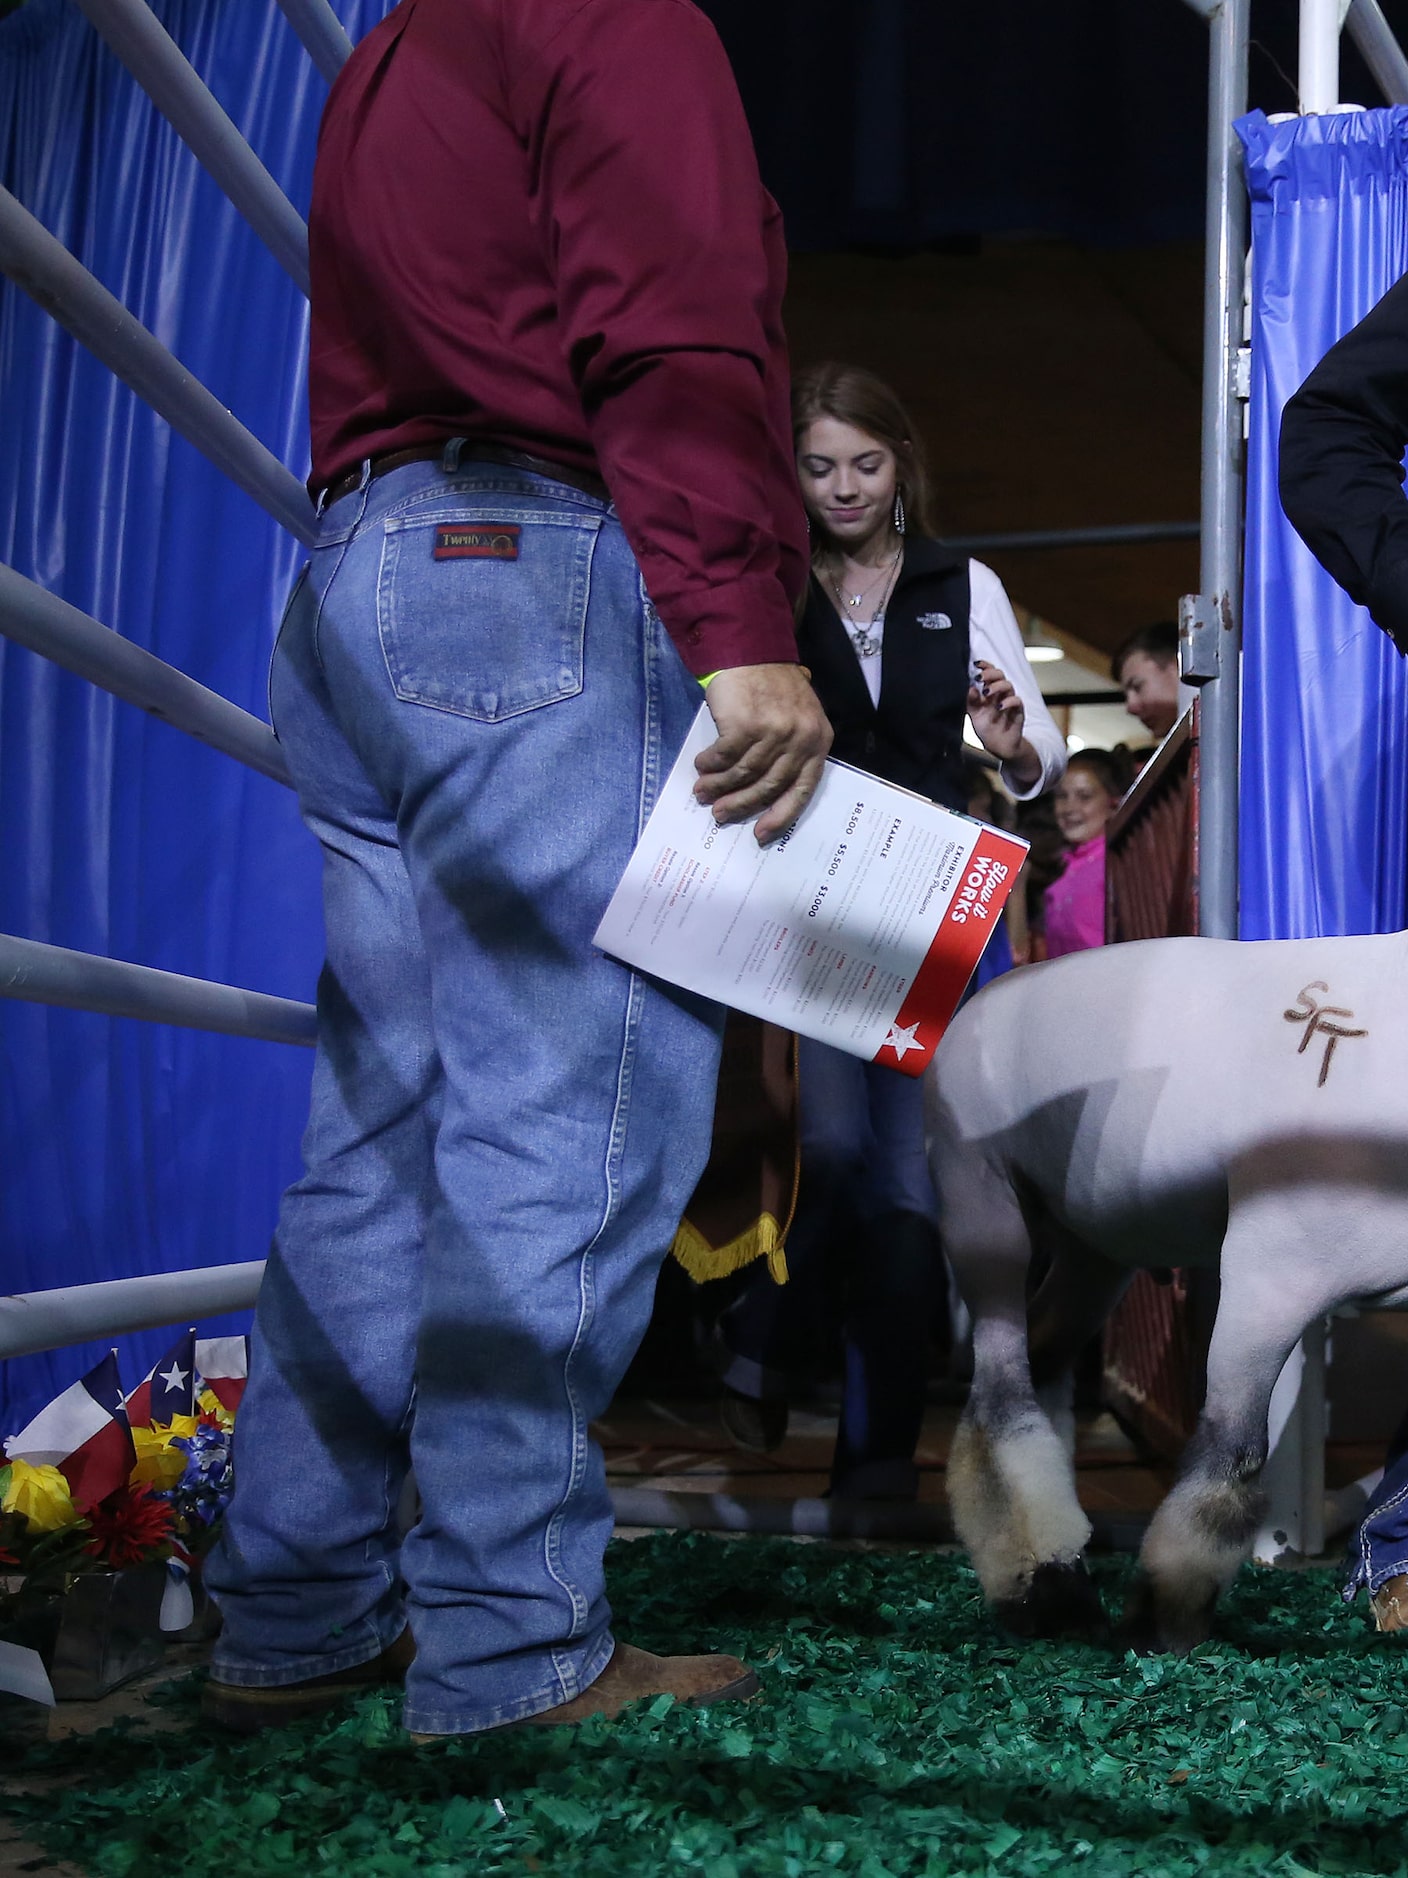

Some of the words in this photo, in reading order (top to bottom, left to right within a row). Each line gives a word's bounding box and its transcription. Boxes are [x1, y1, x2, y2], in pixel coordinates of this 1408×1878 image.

[844, 801, 864, 835] $8,500
[880, 818, 901, 858] EXAMPLE
[827, 843, 846, 876] $5,500
[934, 840, 955, 879] Maximum
[940, 845, 964, 891] EXHIBITOR
[918, 879, 939, 915] Premiums
[951, 855, 992, 923] WORKS
[979, 860, 1008, 902] How
[807, 884, 827, 917] $3,000
[971, 902, 987, 920] it
